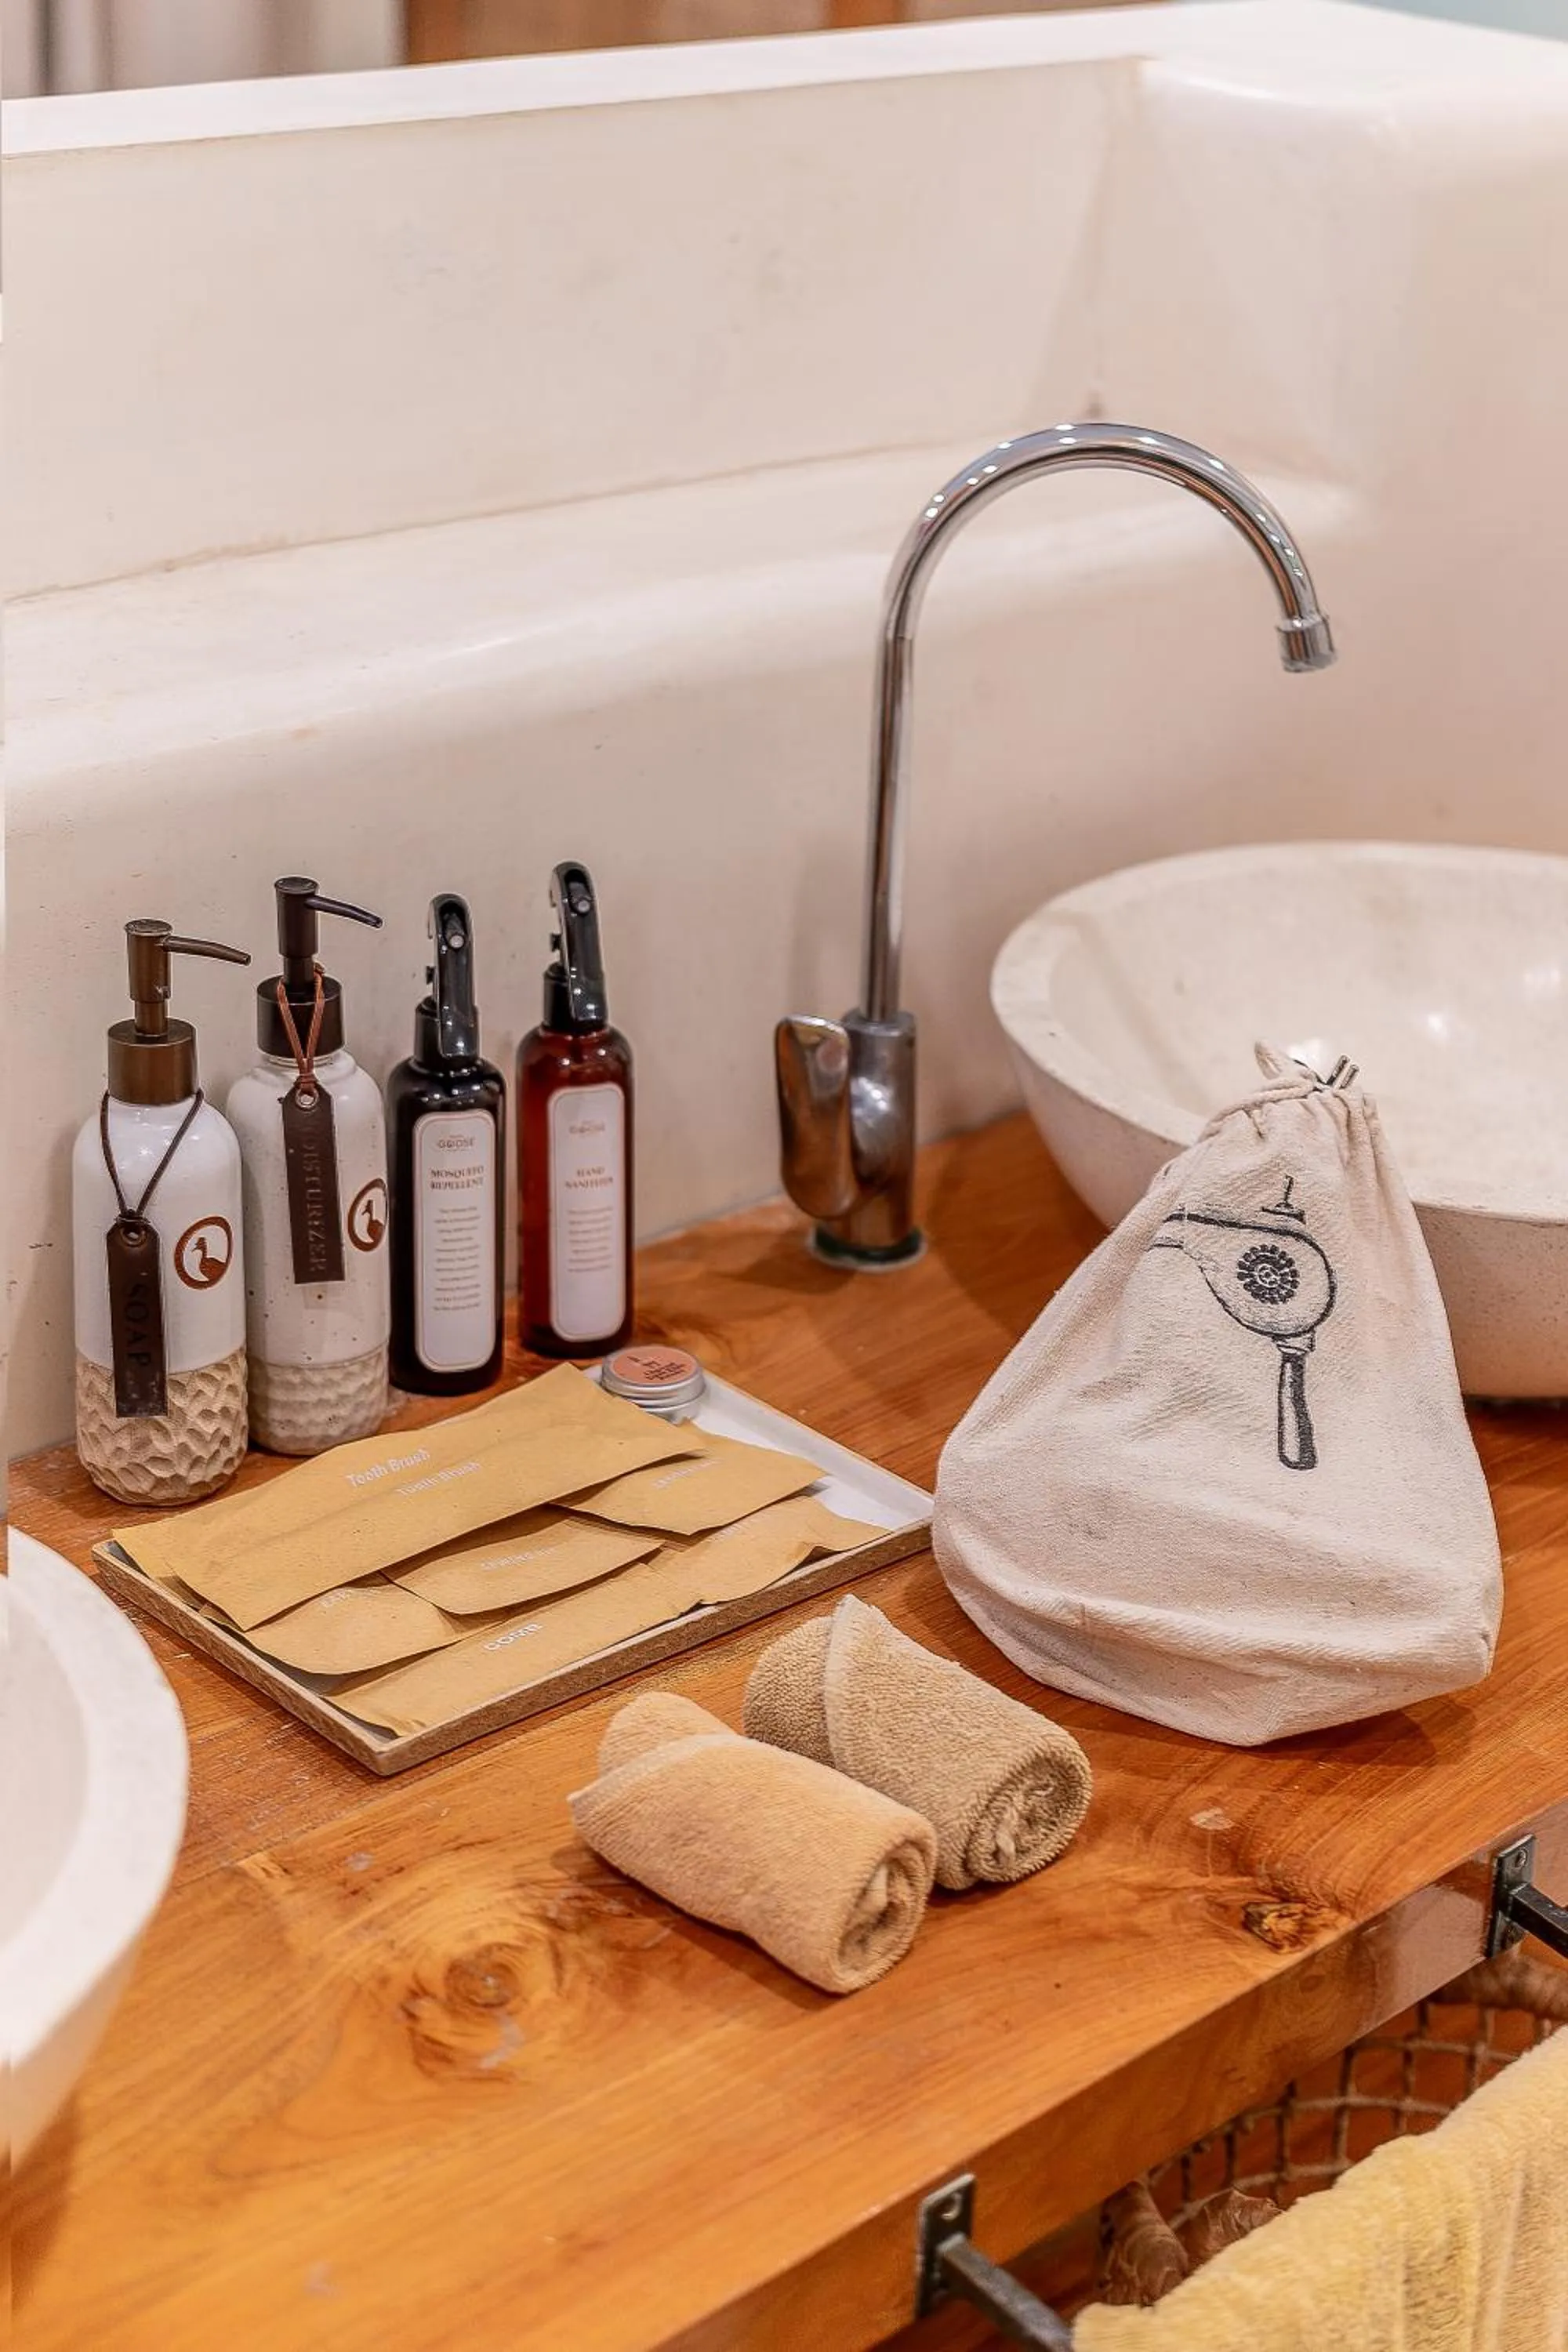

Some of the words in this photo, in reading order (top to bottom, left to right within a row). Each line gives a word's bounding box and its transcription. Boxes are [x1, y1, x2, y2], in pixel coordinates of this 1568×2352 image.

[430, 1166, 485, 1178] MOSQUITO
[576, 1166, 605, 1177] HAND
[300, 1126, 327, 1272] OISTURIZER
[126, 1283, 152, 1366] SOAP
[346, 1465, 389, 1487] Tooth
[389, 1449, 430, 1472] Brush
